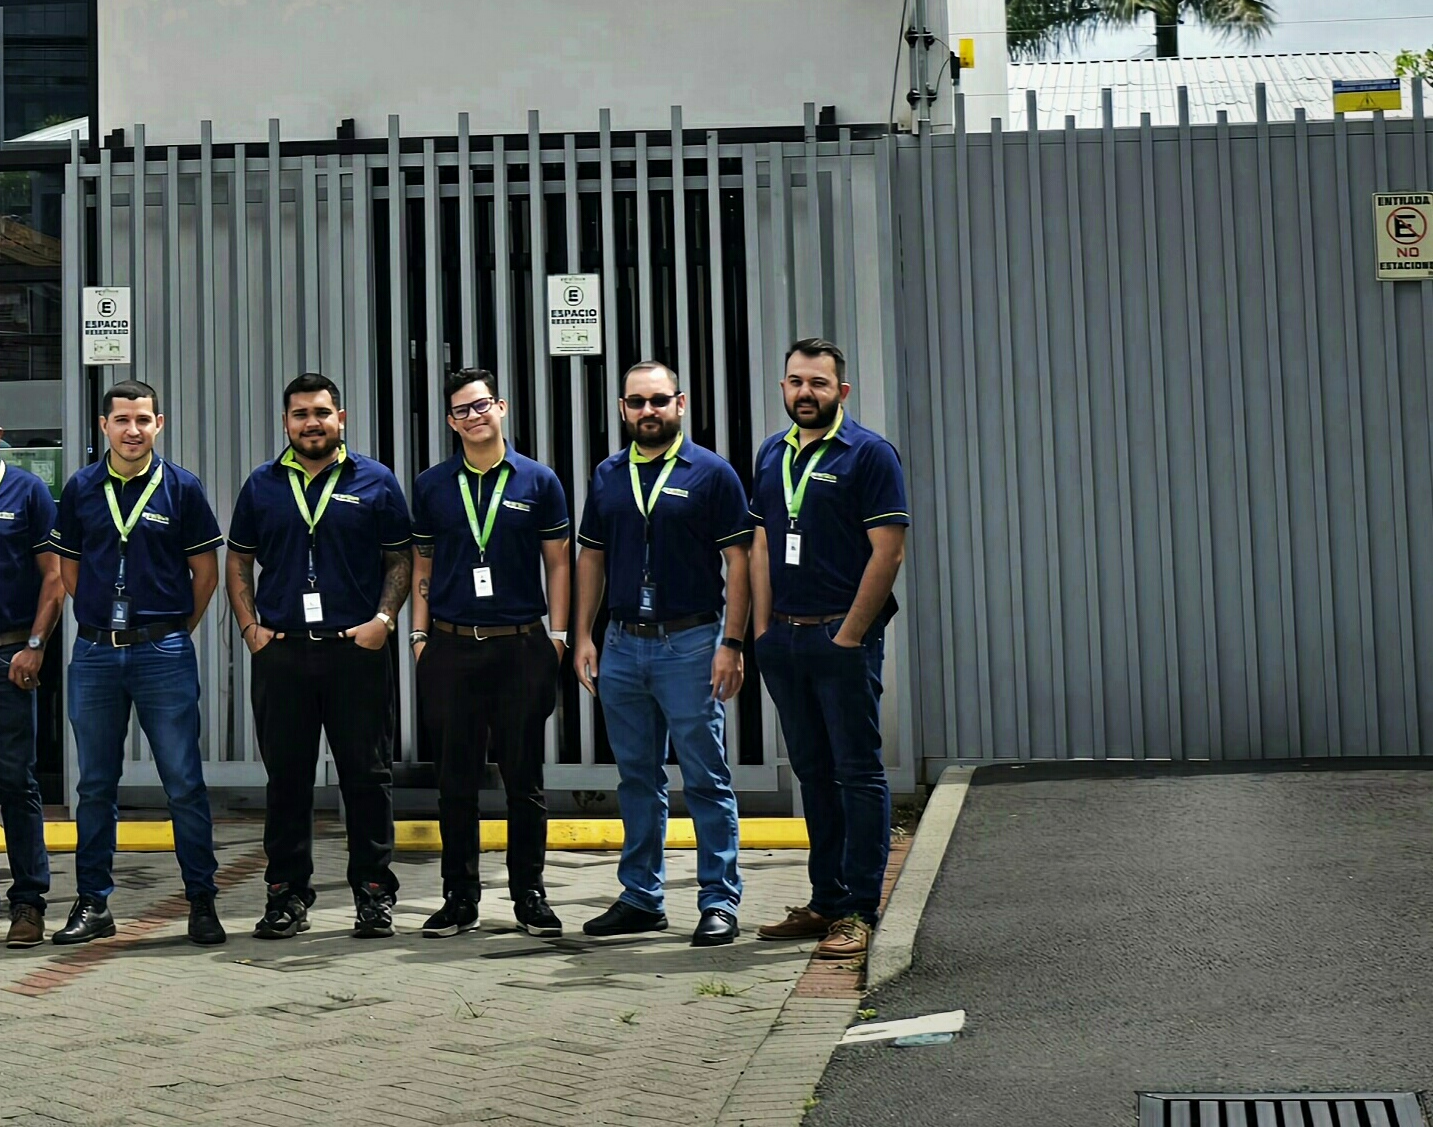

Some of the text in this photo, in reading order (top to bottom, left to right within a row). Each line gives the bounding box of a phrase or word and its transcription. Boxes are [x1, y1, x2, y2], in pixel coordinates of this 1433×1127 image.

[1378, 196, 1430, 206] ENTRADA
[1397, 247, 1419, 257] NO
[551, 309, 597, 317] ESPACIO
[85, 320, 128, 328] ESPACIO
